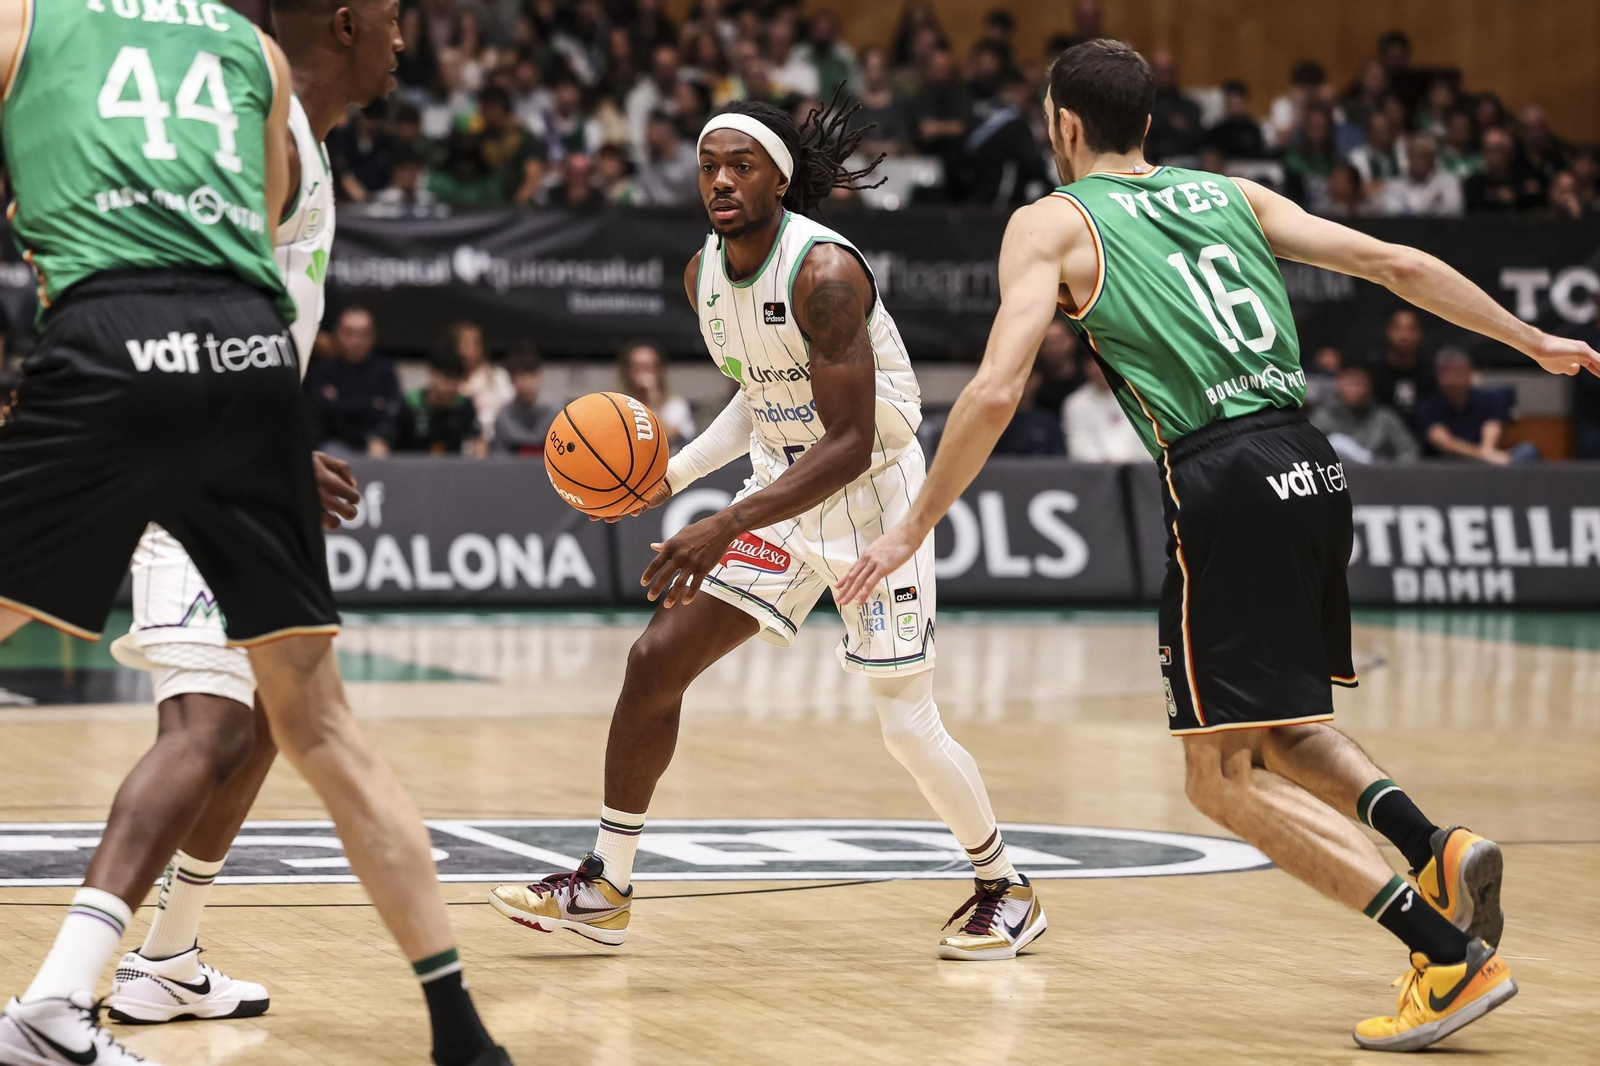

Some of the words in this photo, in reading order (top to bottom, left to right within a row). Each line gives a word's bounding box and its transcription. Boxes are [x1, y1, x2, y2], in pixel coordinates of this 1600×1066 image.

[97, 46, 243, 174] 44
[1108, 180, 1229, 218] VIVES
[1166, 243, 1277, 354] 16
[125, 331, 200, 374] vdf
[550, 430, 567, 456] acb
[1265, 461, 1318, 500] vdf
[1350, 504, 1600, 567] TRELLA
[896, 592, 913, 602] acb
[1392, 566, 1517, 603] DAMM
